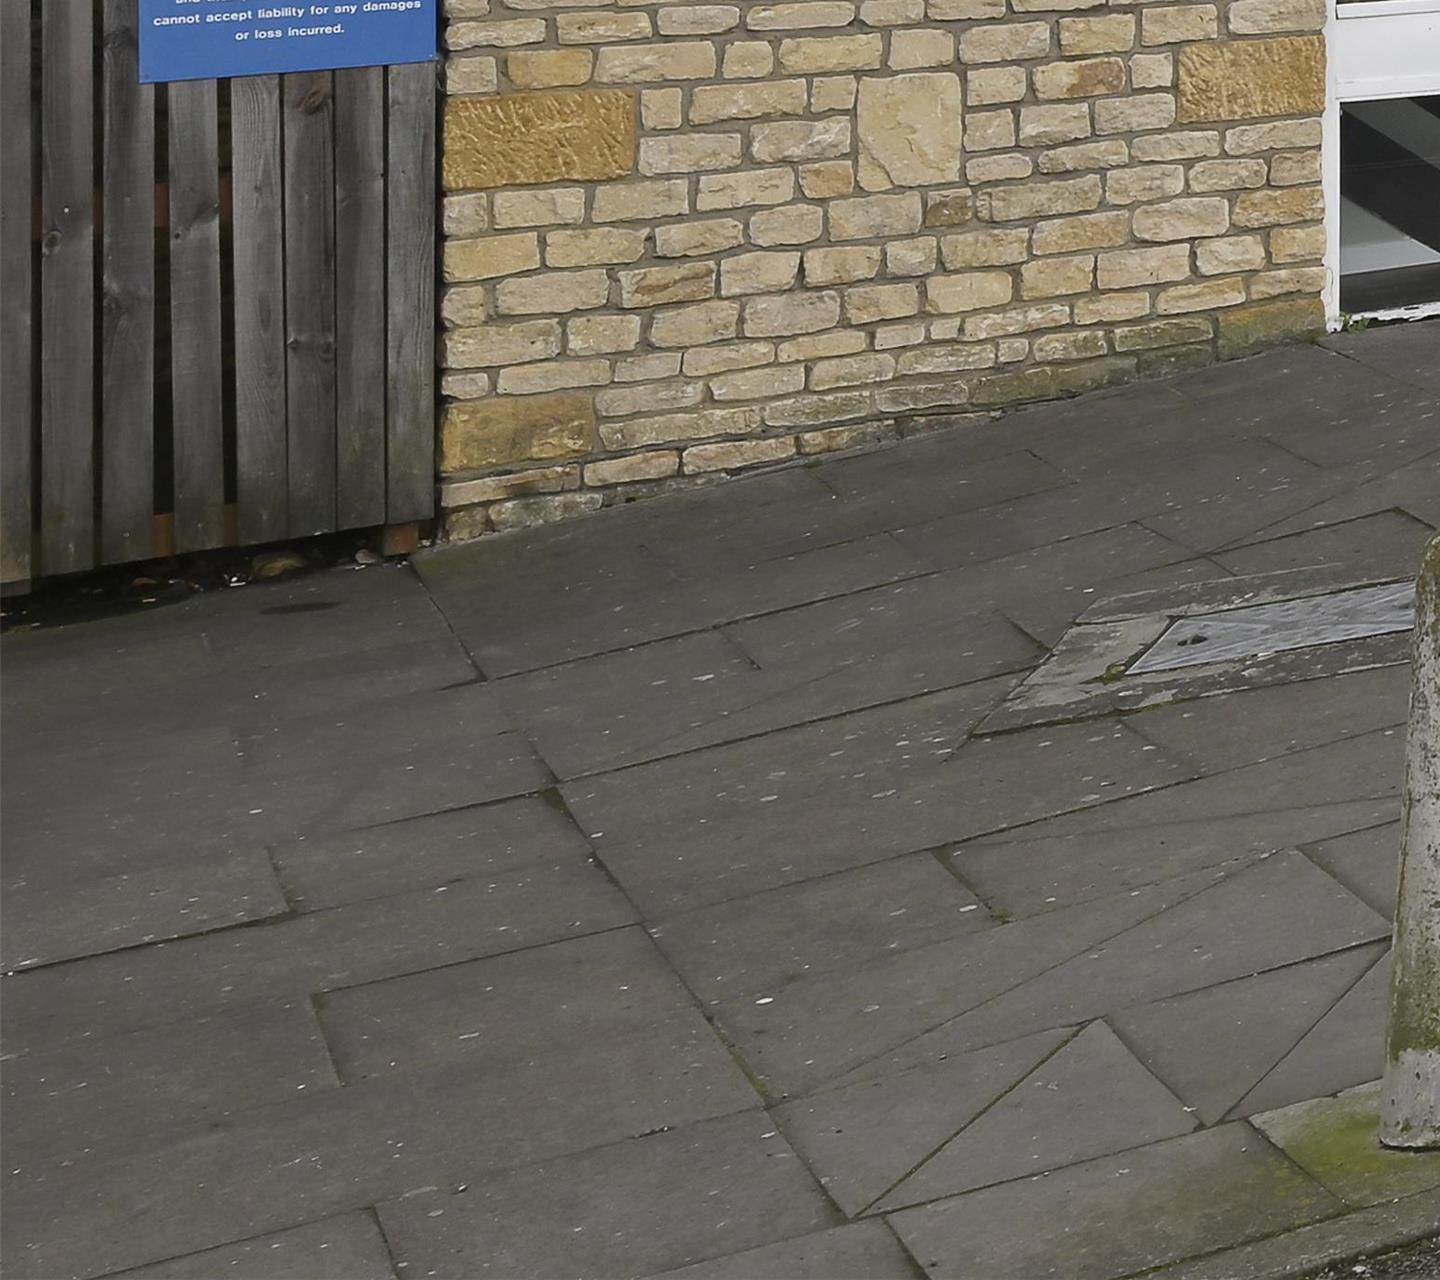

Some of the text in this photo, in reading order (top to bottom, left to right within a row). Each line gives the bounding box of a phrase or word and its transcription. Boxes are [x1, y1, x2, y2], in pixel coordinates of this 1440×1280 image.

[153, 0, 421, 26] cannot accept liability for any damages
[235, 23, 345, 41] or loss incurred.
